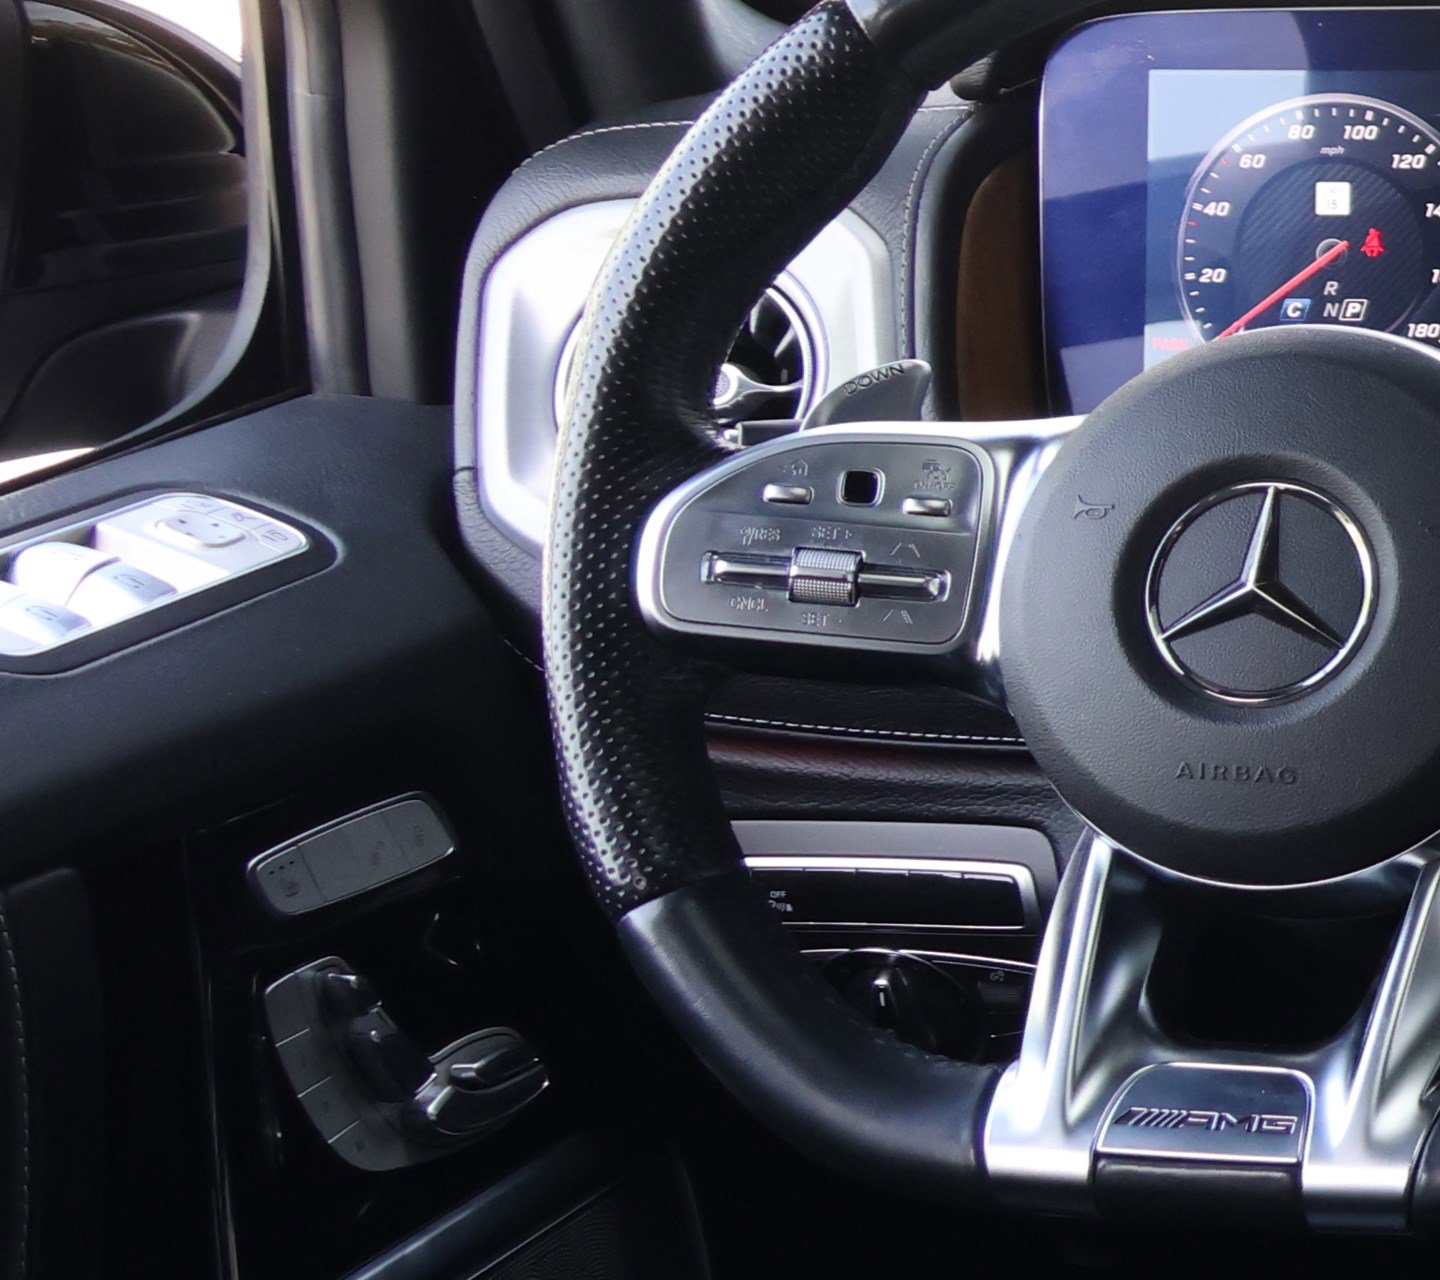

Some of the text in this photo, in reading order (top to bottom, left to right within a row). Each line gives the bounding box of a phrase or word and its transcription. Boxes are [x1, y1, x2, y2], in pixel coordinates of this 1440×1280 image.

[1288, 125, 1316, 140] 80
[1344, 125, 1379, 140] 100
[1320, 145, 1345, 157] mph
[1239, 154, 1266, 169] 60
[1391, 154, 1426, 169] 120
[1203, 202, 1230, 217] 40
[1199, 269, 1226, 284] 20
[1323, 281, 1339, 296] R
[1286, 302, 1303, 318] C
[1323, 303, 1340, 318] N
[1345, 303, 1362, 318] P
[1407, 323, 1440, 339] 180
[843, 363, 905, 396] DOWN
[1175, 760, 1297, 785] AIRBAG
